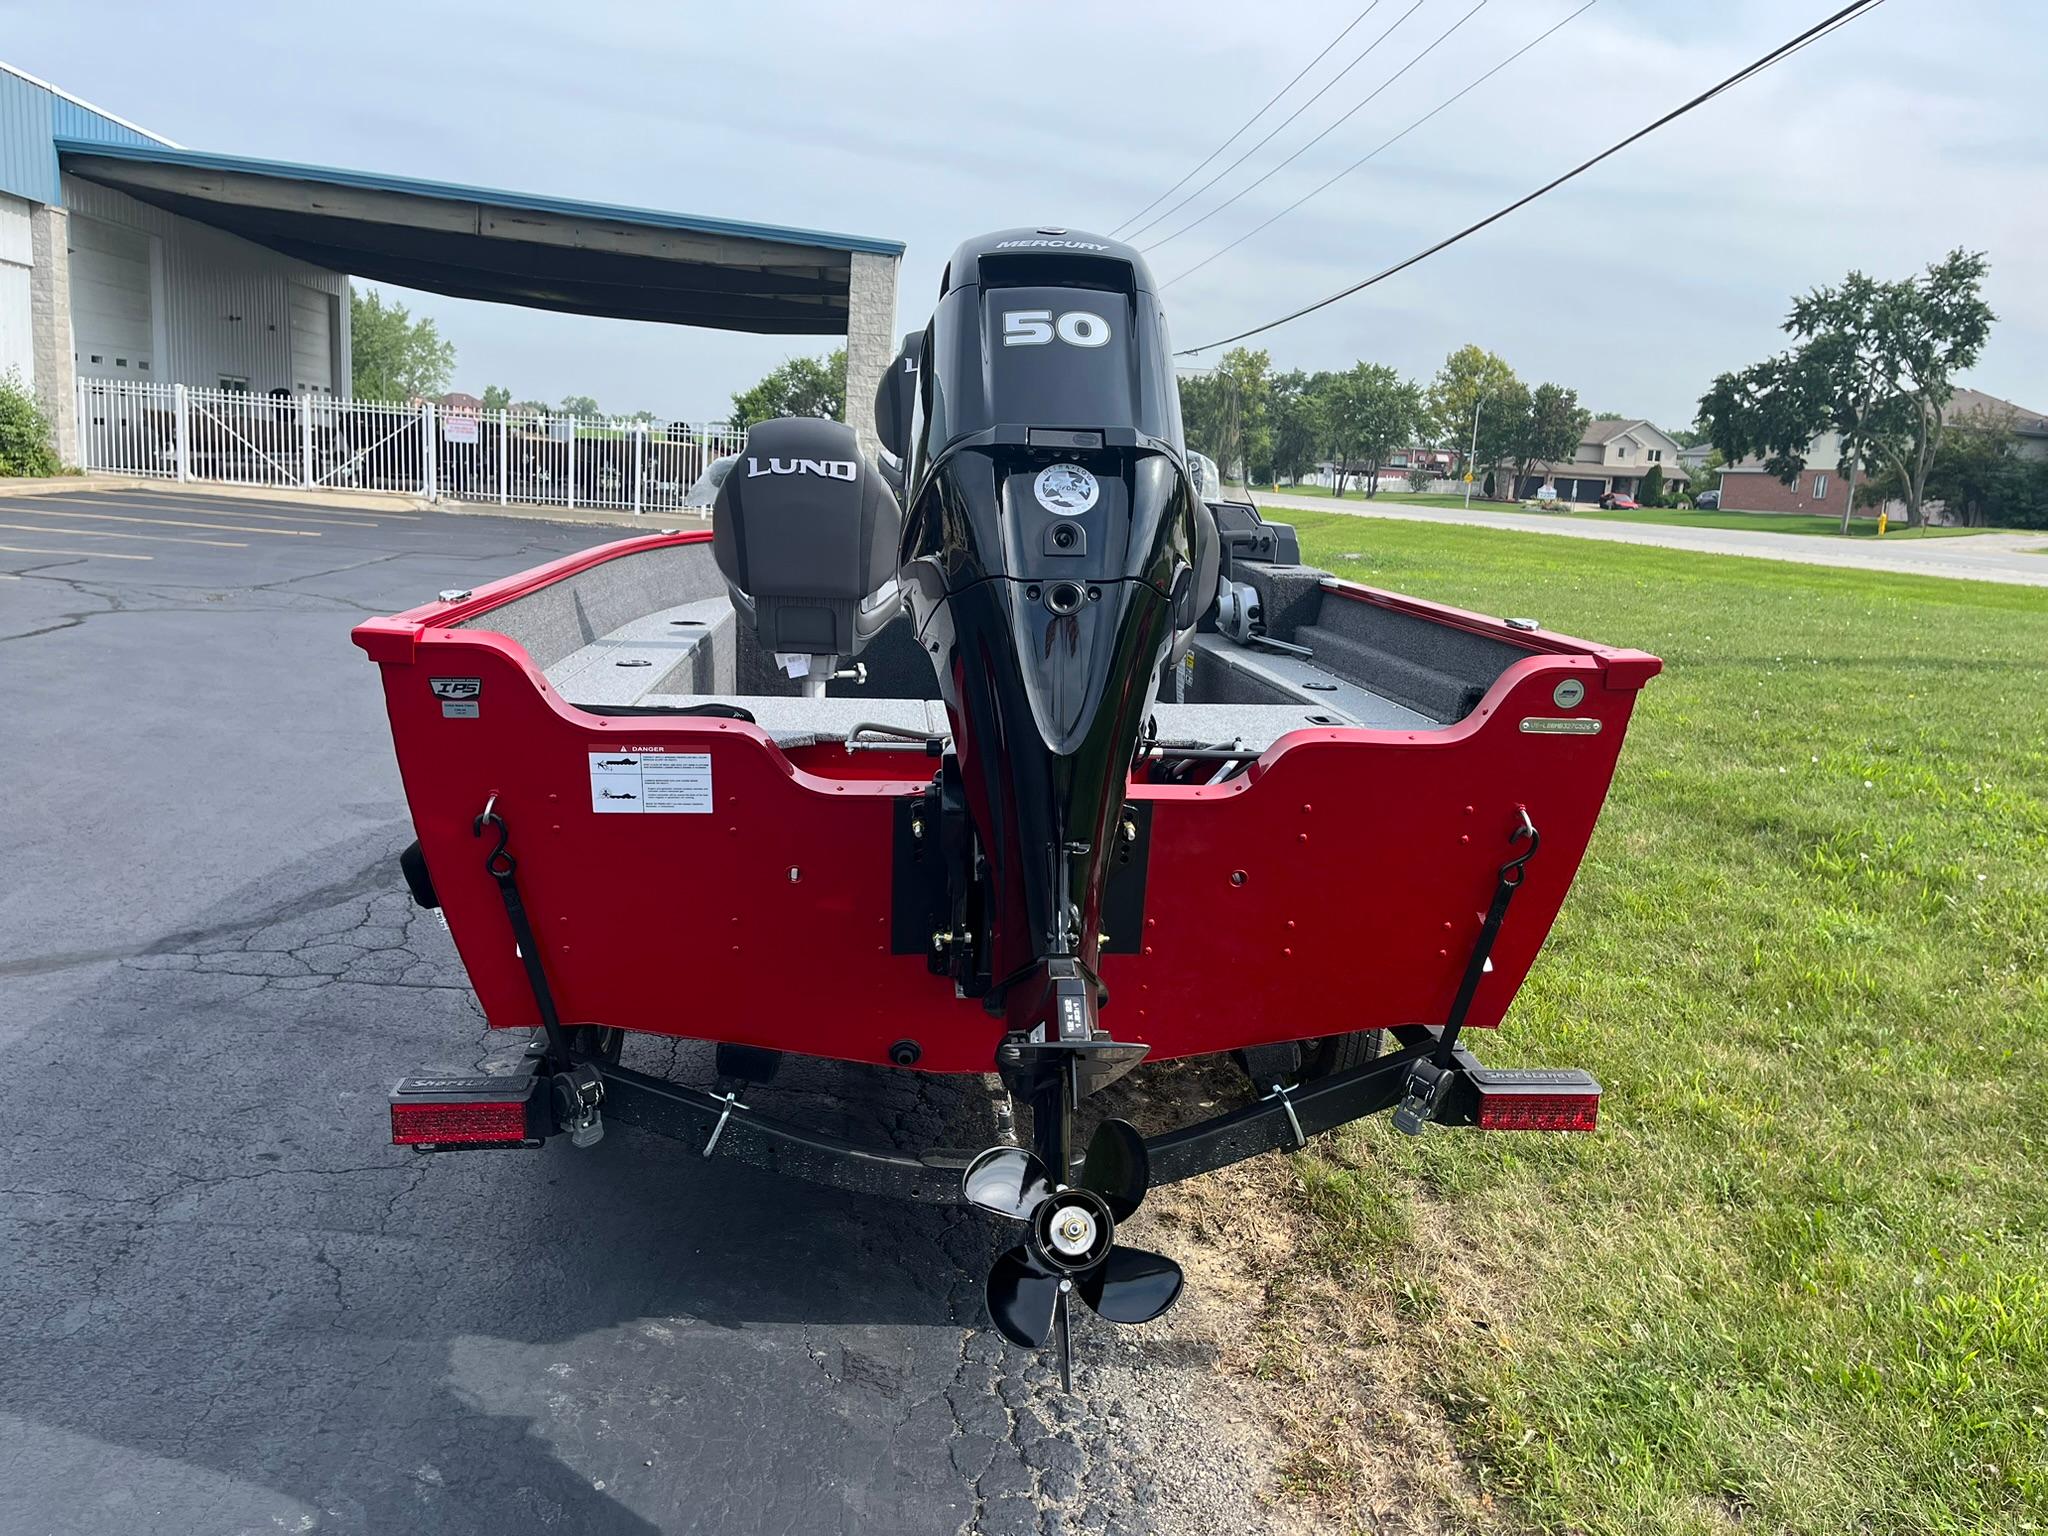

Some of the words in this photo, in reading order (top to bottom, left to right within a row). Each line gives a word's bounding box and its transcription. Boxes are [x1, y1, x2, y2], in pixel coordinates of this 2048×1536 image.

[996, 239, 1110, 251] MERCURY
[1003, 310, 1111, 348] 50
[747, 457, 857, 482] LUND
[437, 683, 478, 694] IPS
